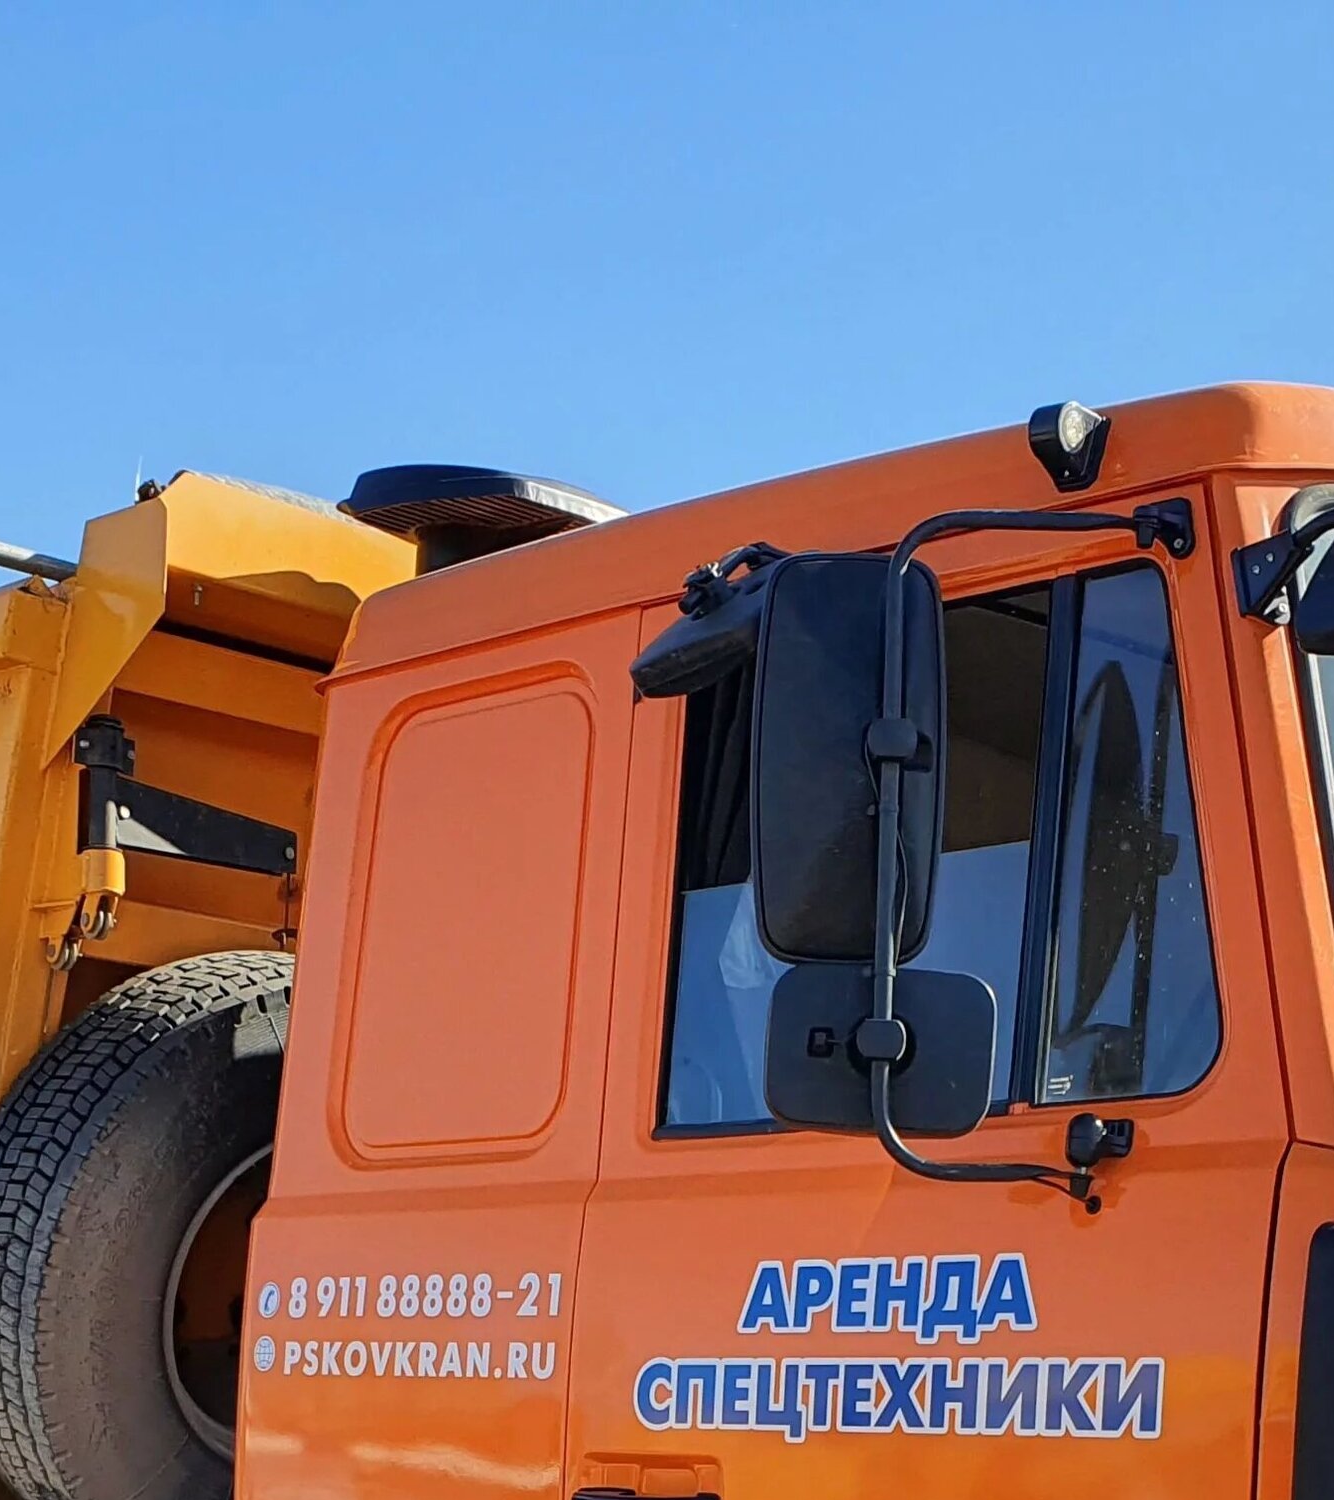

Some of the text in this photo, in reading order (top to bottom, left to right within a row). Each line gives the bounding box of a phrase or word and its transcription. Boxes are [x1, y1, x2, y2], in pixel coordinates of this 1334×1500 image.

[288, 1272, 562, 1319] 8 911 88888-21
[738, 1253, 1037, 1344] АРЕНДА
[283, 1340, 556, 1380] PSKOVKRAN.RU
[633, 1357, 1165, 1443] СПЕЦТЕХНИКИ
